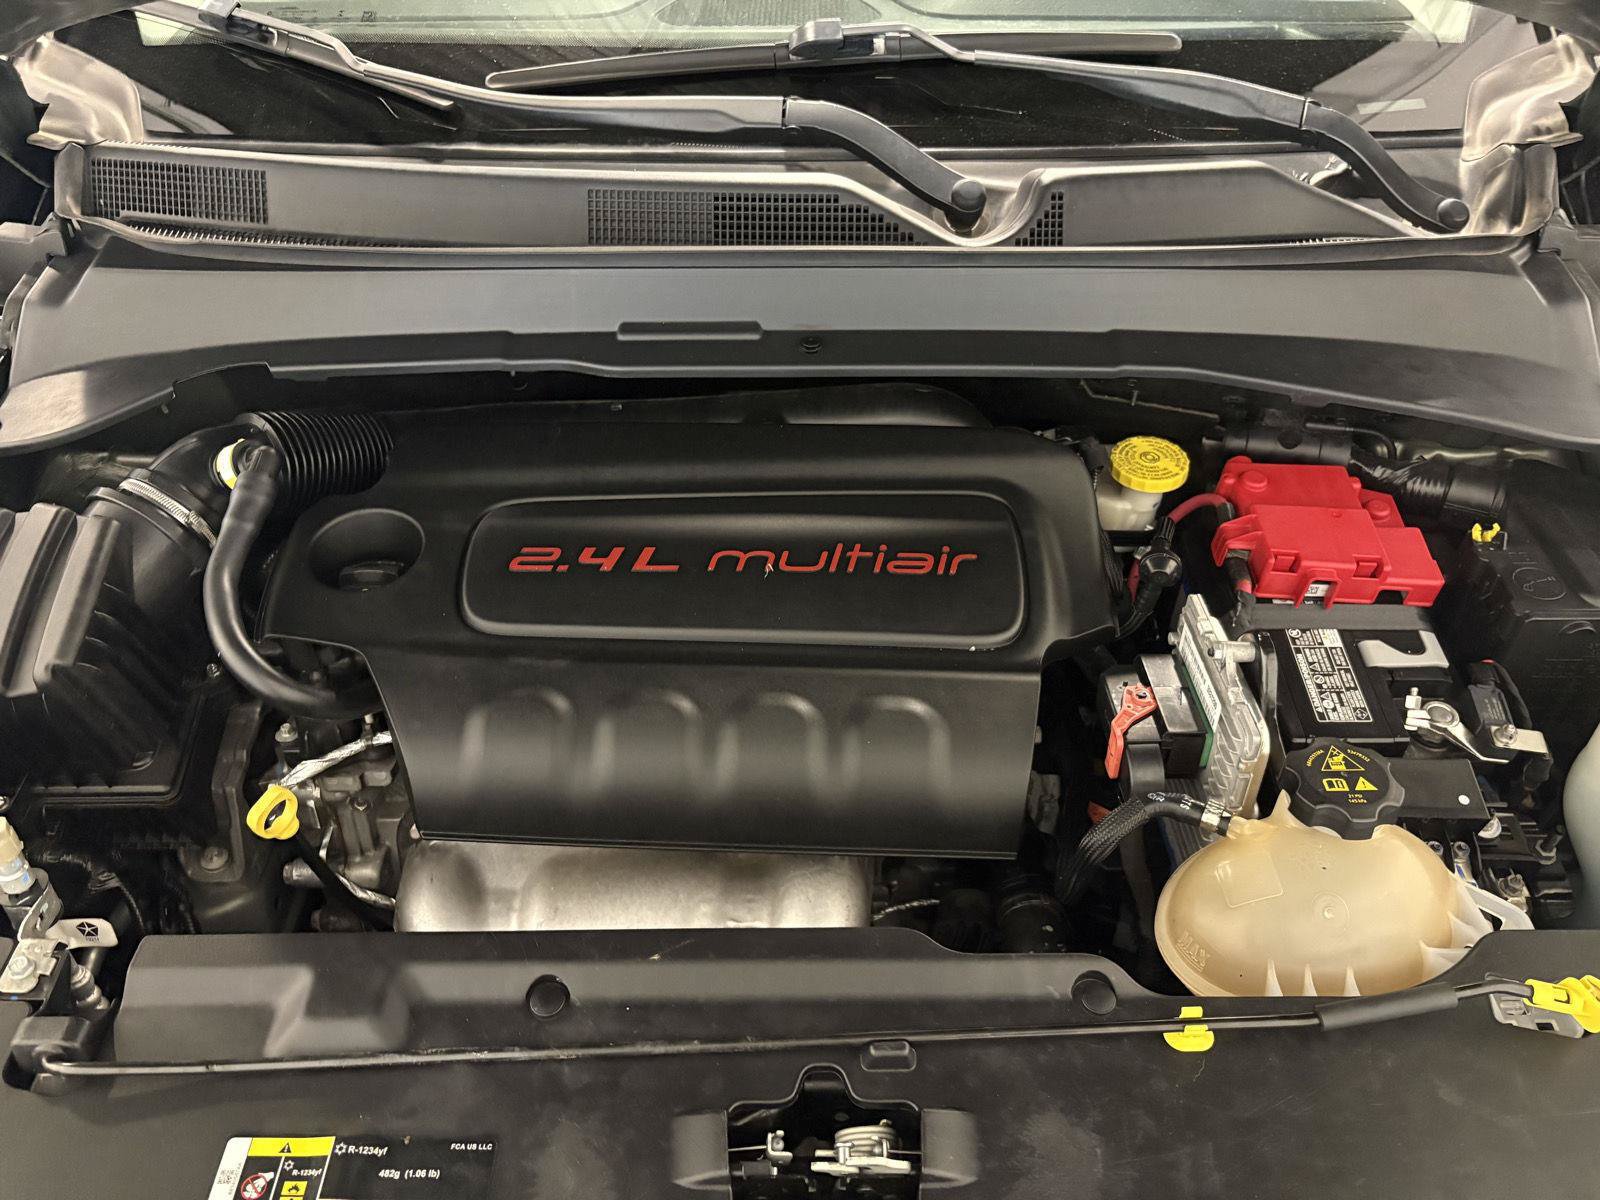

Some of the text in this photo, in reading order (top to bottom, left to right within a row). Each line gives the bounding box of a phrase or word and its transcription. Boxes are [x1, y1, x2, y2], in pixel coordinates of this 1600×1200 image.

[707, 543, 978, 576] multiair
[348, 1145, 388, 1157] R-1234yf
[291, 1168, 322, 1177] R-1234yf
[378, 1169, 400, 1179] 482g
[428, 1169, 441, 1179] lb)
